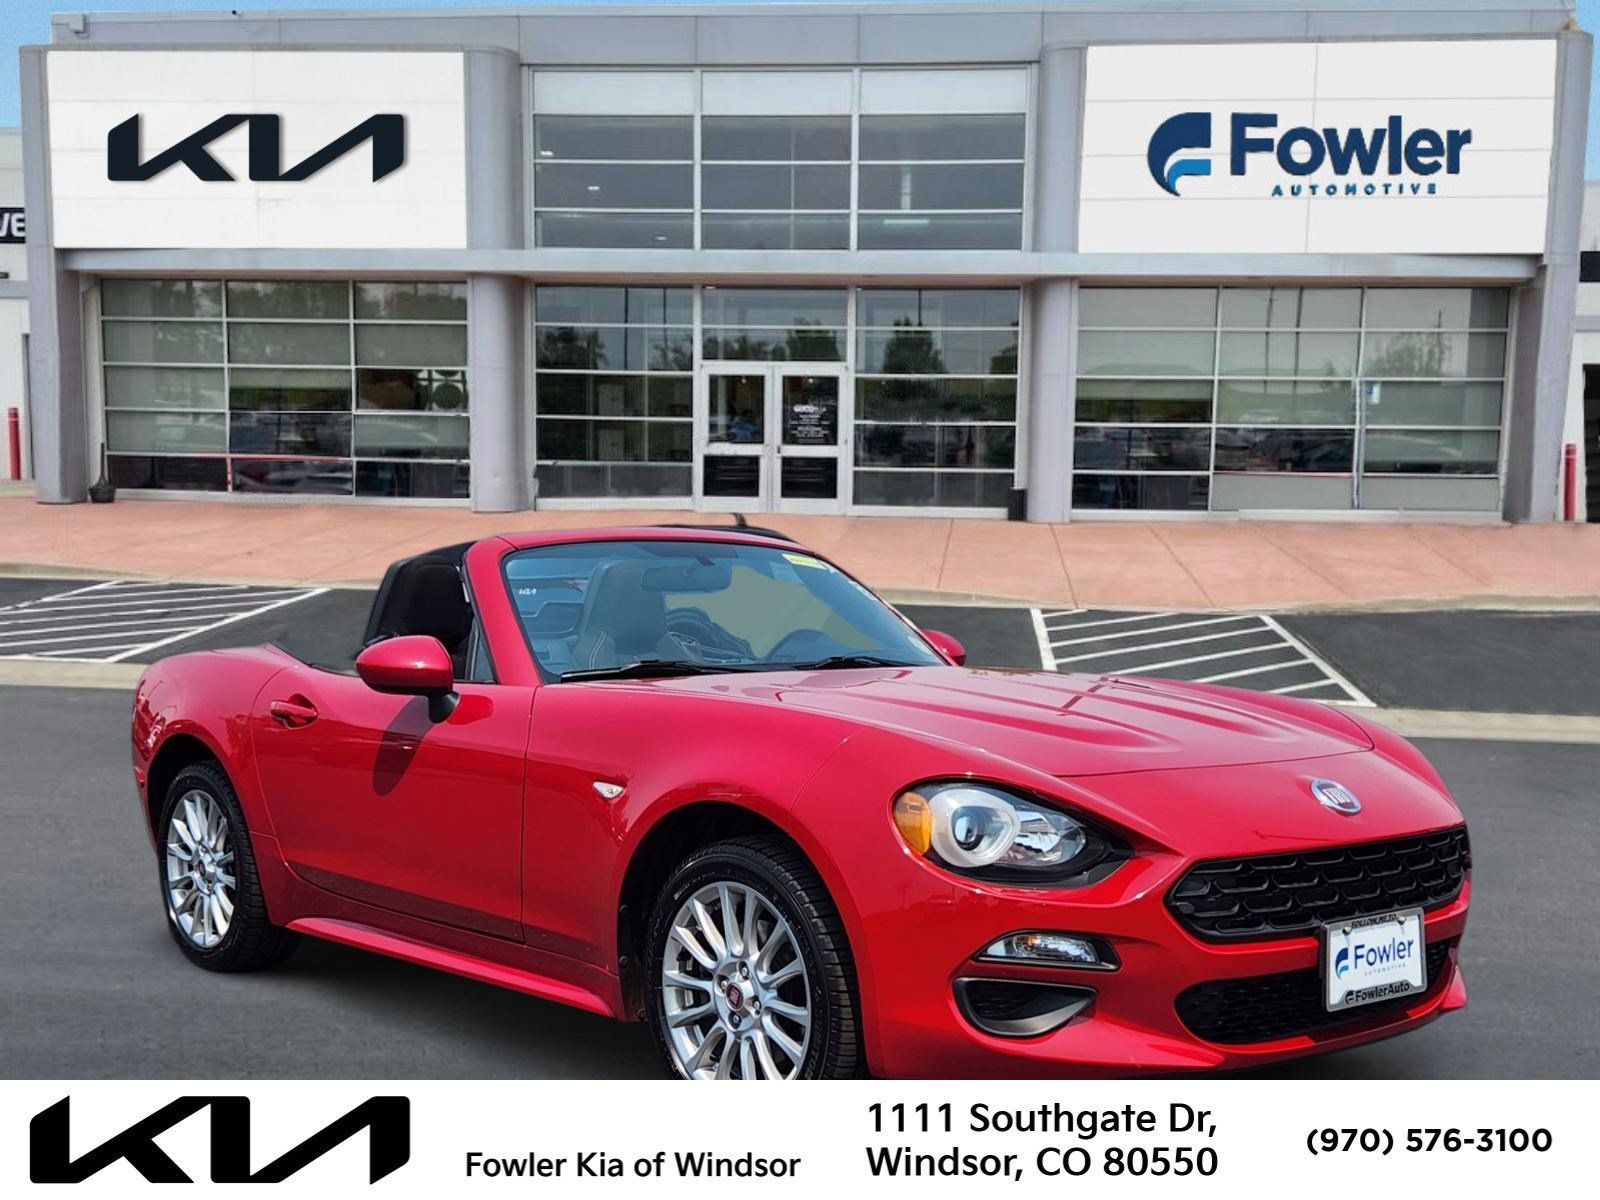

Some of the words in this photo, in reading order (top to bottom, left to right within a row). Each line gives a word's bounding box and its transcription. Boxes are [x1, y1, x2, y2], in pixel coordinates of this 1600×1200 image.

[108, 114, 404, 182] KIA
[1230, 112, 1472, 176] Fowler
[1271, 182, 1437, 197] AUTOMOTIVE
[1354, 937, 1414, 970] Fowler
[1355, 982, 1410, 1002] FowlerAuto
